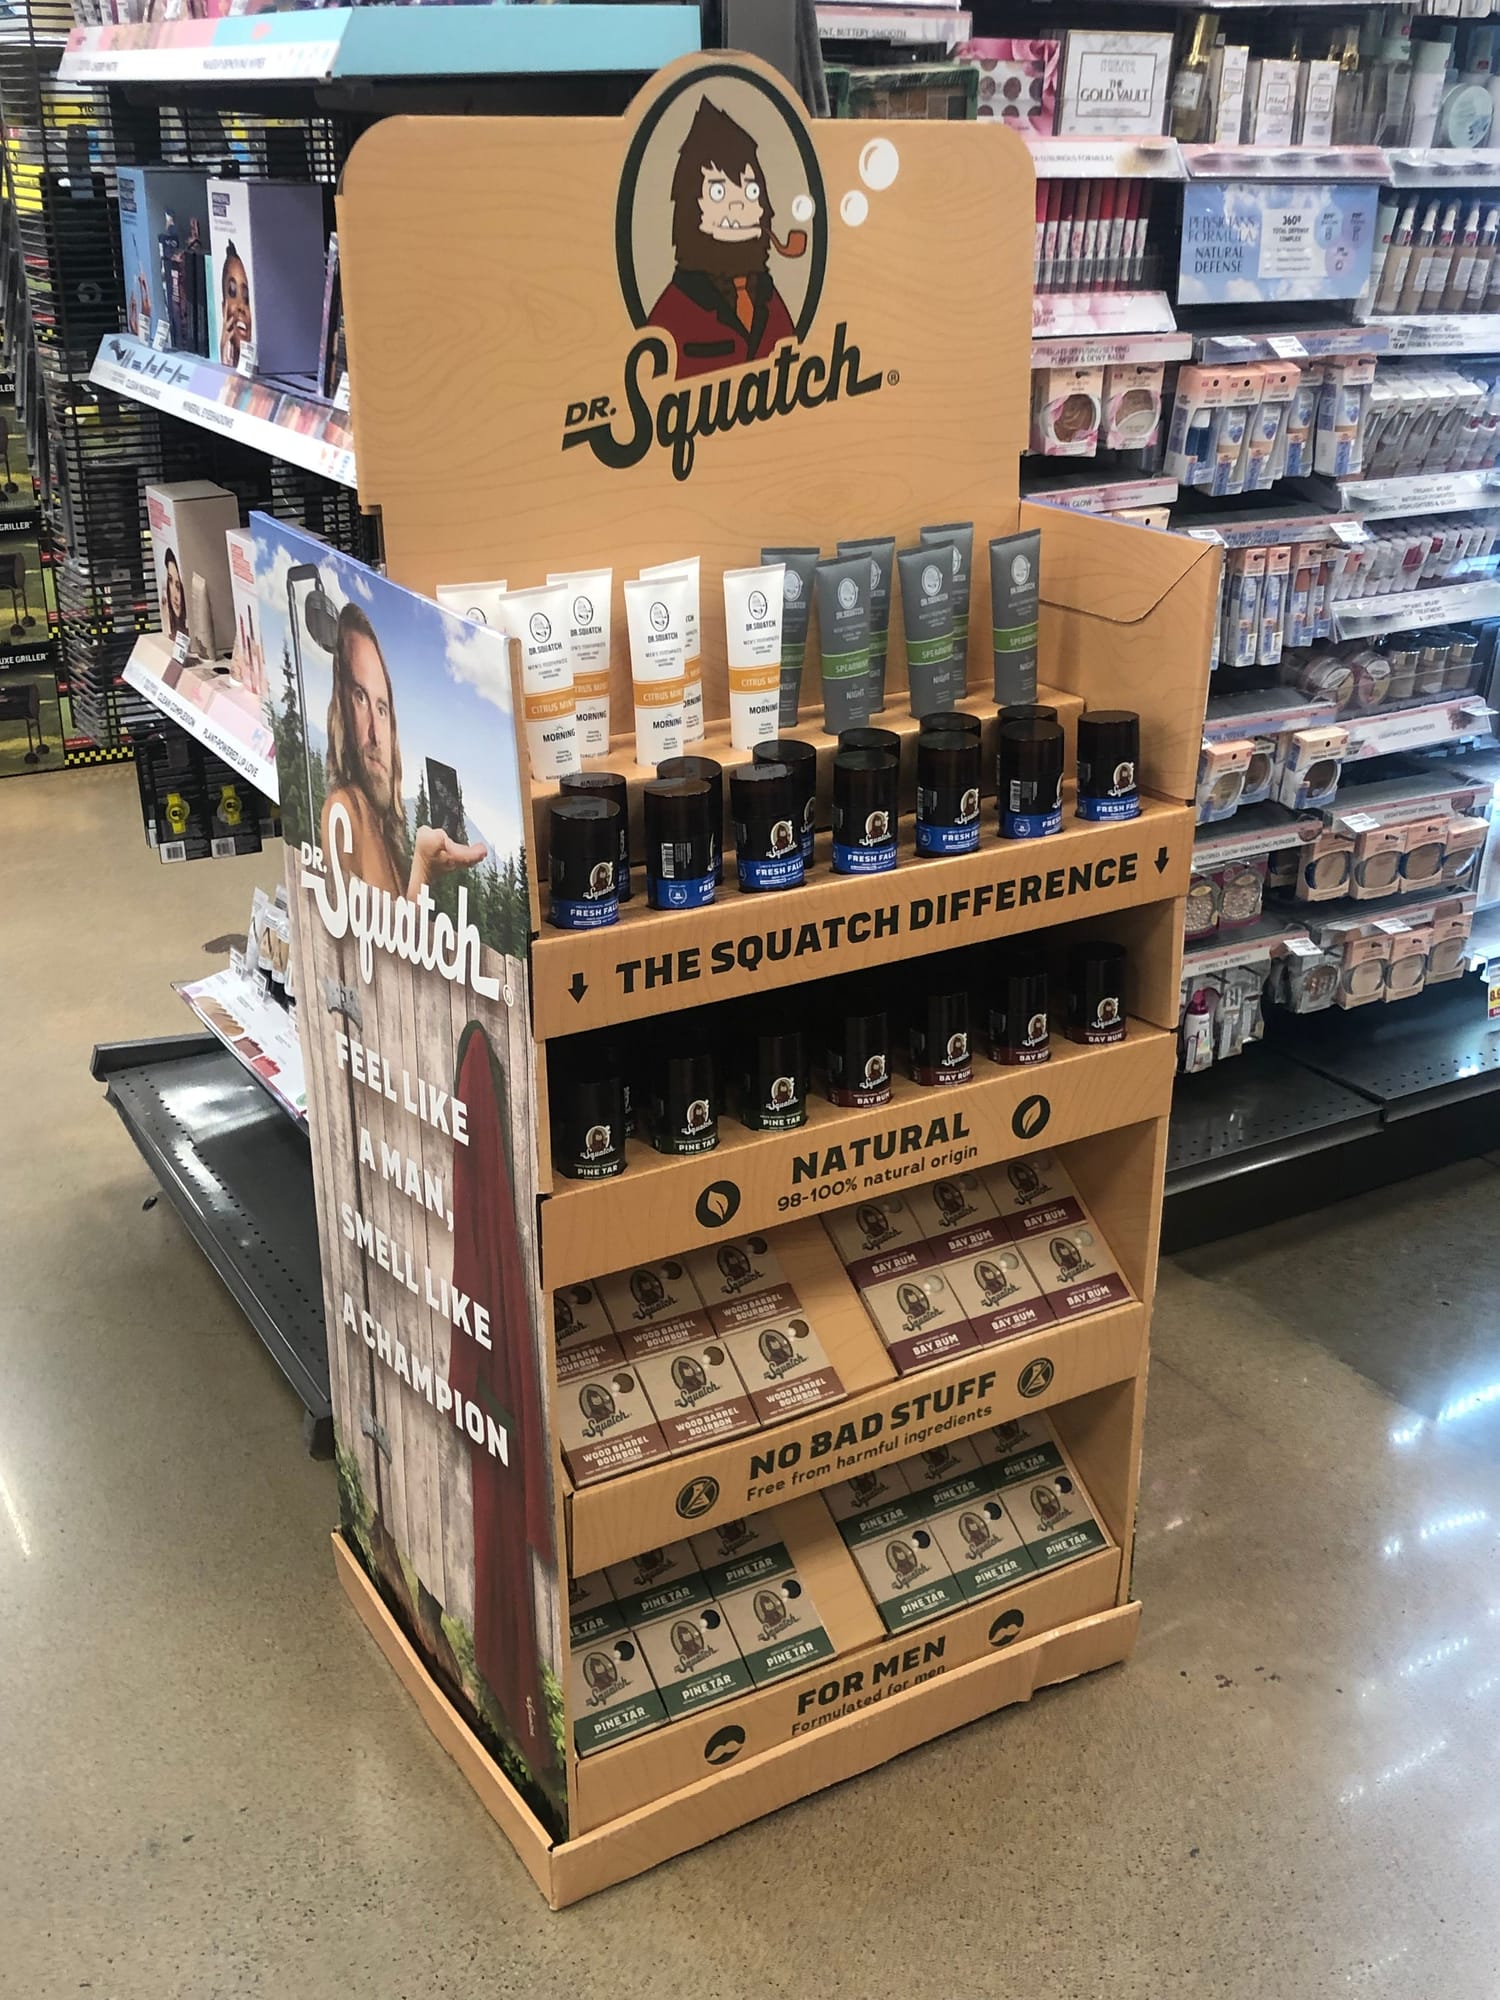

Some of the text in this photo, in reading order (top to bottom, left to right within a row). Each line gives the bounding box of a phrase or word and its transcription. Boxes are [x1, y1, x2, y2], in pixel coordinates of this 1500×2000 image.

[1080, 88, 1149, 102] GOLD VAULT
[1195, 246, 1245, 260] NATURAL
[1194, 260, 1244, 274] DEFENSE
[562, 322, 883, 481] DR. Squatch
[15, 654, 47, 664] GRILLER
[741, 676, 767, 687] CITRUS
[643, 690, 669, 702] CITRUS
[531, 703, 558, 715] CITRUS
[576, 710, 607, 722] MORNING
[749, 702, 778, 715] MORNING
[653, 717, 682, 729] MORNING
[542, 728, 576, 743] MORNING
[942, 833, 970, 842] FRESH
[848, 854, 877, 862] FRESH
[756, 868, 786, 876] FRESH
[301, 802, 499, 1001] DR. Squatch
[570, 909, 602, 917] FRESH
[616, 852, 1138, 994] THE SQUATCH DIFFERENCE
[335, 1031, 470, 1147] FEEL LIKE
[763, 1118, 785, 1126] PINE
[679, 1142, 701, 1151] PINE
[791, 1112, 970, 1184] NATURAL
[359, 1126, 455, 1233] A MAN,
[577, 1168, 600, 1176] PINE
[777, 1145, 978, 1211] 98-100% natural origin
[1023, 1208, 1067, 1228] BAY RUM
[948, 1230, 993, 1250] BAY RUM
[871, 1254, 917, 1274] BAY RUM
[341, 1202, 493, 1351] SMELL LIKE
[723, 1293, 783, 1317] WOOD BARREL
[1066, 1286, 1111, 1306] BAY RUM
[736, 1303, 777, 1321] BOURBON
[991, 1310, 1036, 1331] BAY RUM
[633, 1319, 696, 1344] WOOD BARREL
[647, 1329, 689, 1348] BOURBON
[912, 1334, 959, 1356] BAY RUM
[342, 1292, 510, 1468] A CHAMPION
[766, 1378, 827, 1404] WOOD BARREL
[779, 1388, 821, 1408] BOURBON
[675, 1406, 740, 1432] WOOD BARREL
[689, 1417, 733, 1437] BOURBON
[750, 1371, 997, 1480] NO BAD STUFF
[583, 1436, 650, 1464] WOOD BARREL
[597, 1446, 642, 1467] BOURBON
[747, 1406, 993, 1502] Free from harmful ingredients
[1004, 1455, 1047, 1476] PINE TAR
[932, 1481, 977, 1504] PINE TAR
[860, 1509, 904, 1532] PINE TAR
[1046, 1533, 1088, 1556] PINE TAR
[725, 1557, 774, 1581] PINE TAR
[974, 1560, 1019, 1584] PINE TAR
[641, 1587, 691, 1612] PINE TAR
[900, 1590, 946, 1614] PINE TAR
[582, 1618, 605, 1632] TAR
[766, 1642, 815, 1667] PINE TAR
[797, 1635, 946, 1716] FOR MEN
[681, 1675, 732, 1700] PINE TAR
[791, 1665, 945, 1736] Formulated for men
[594, 1707, 646, 1734] PINE TAR
